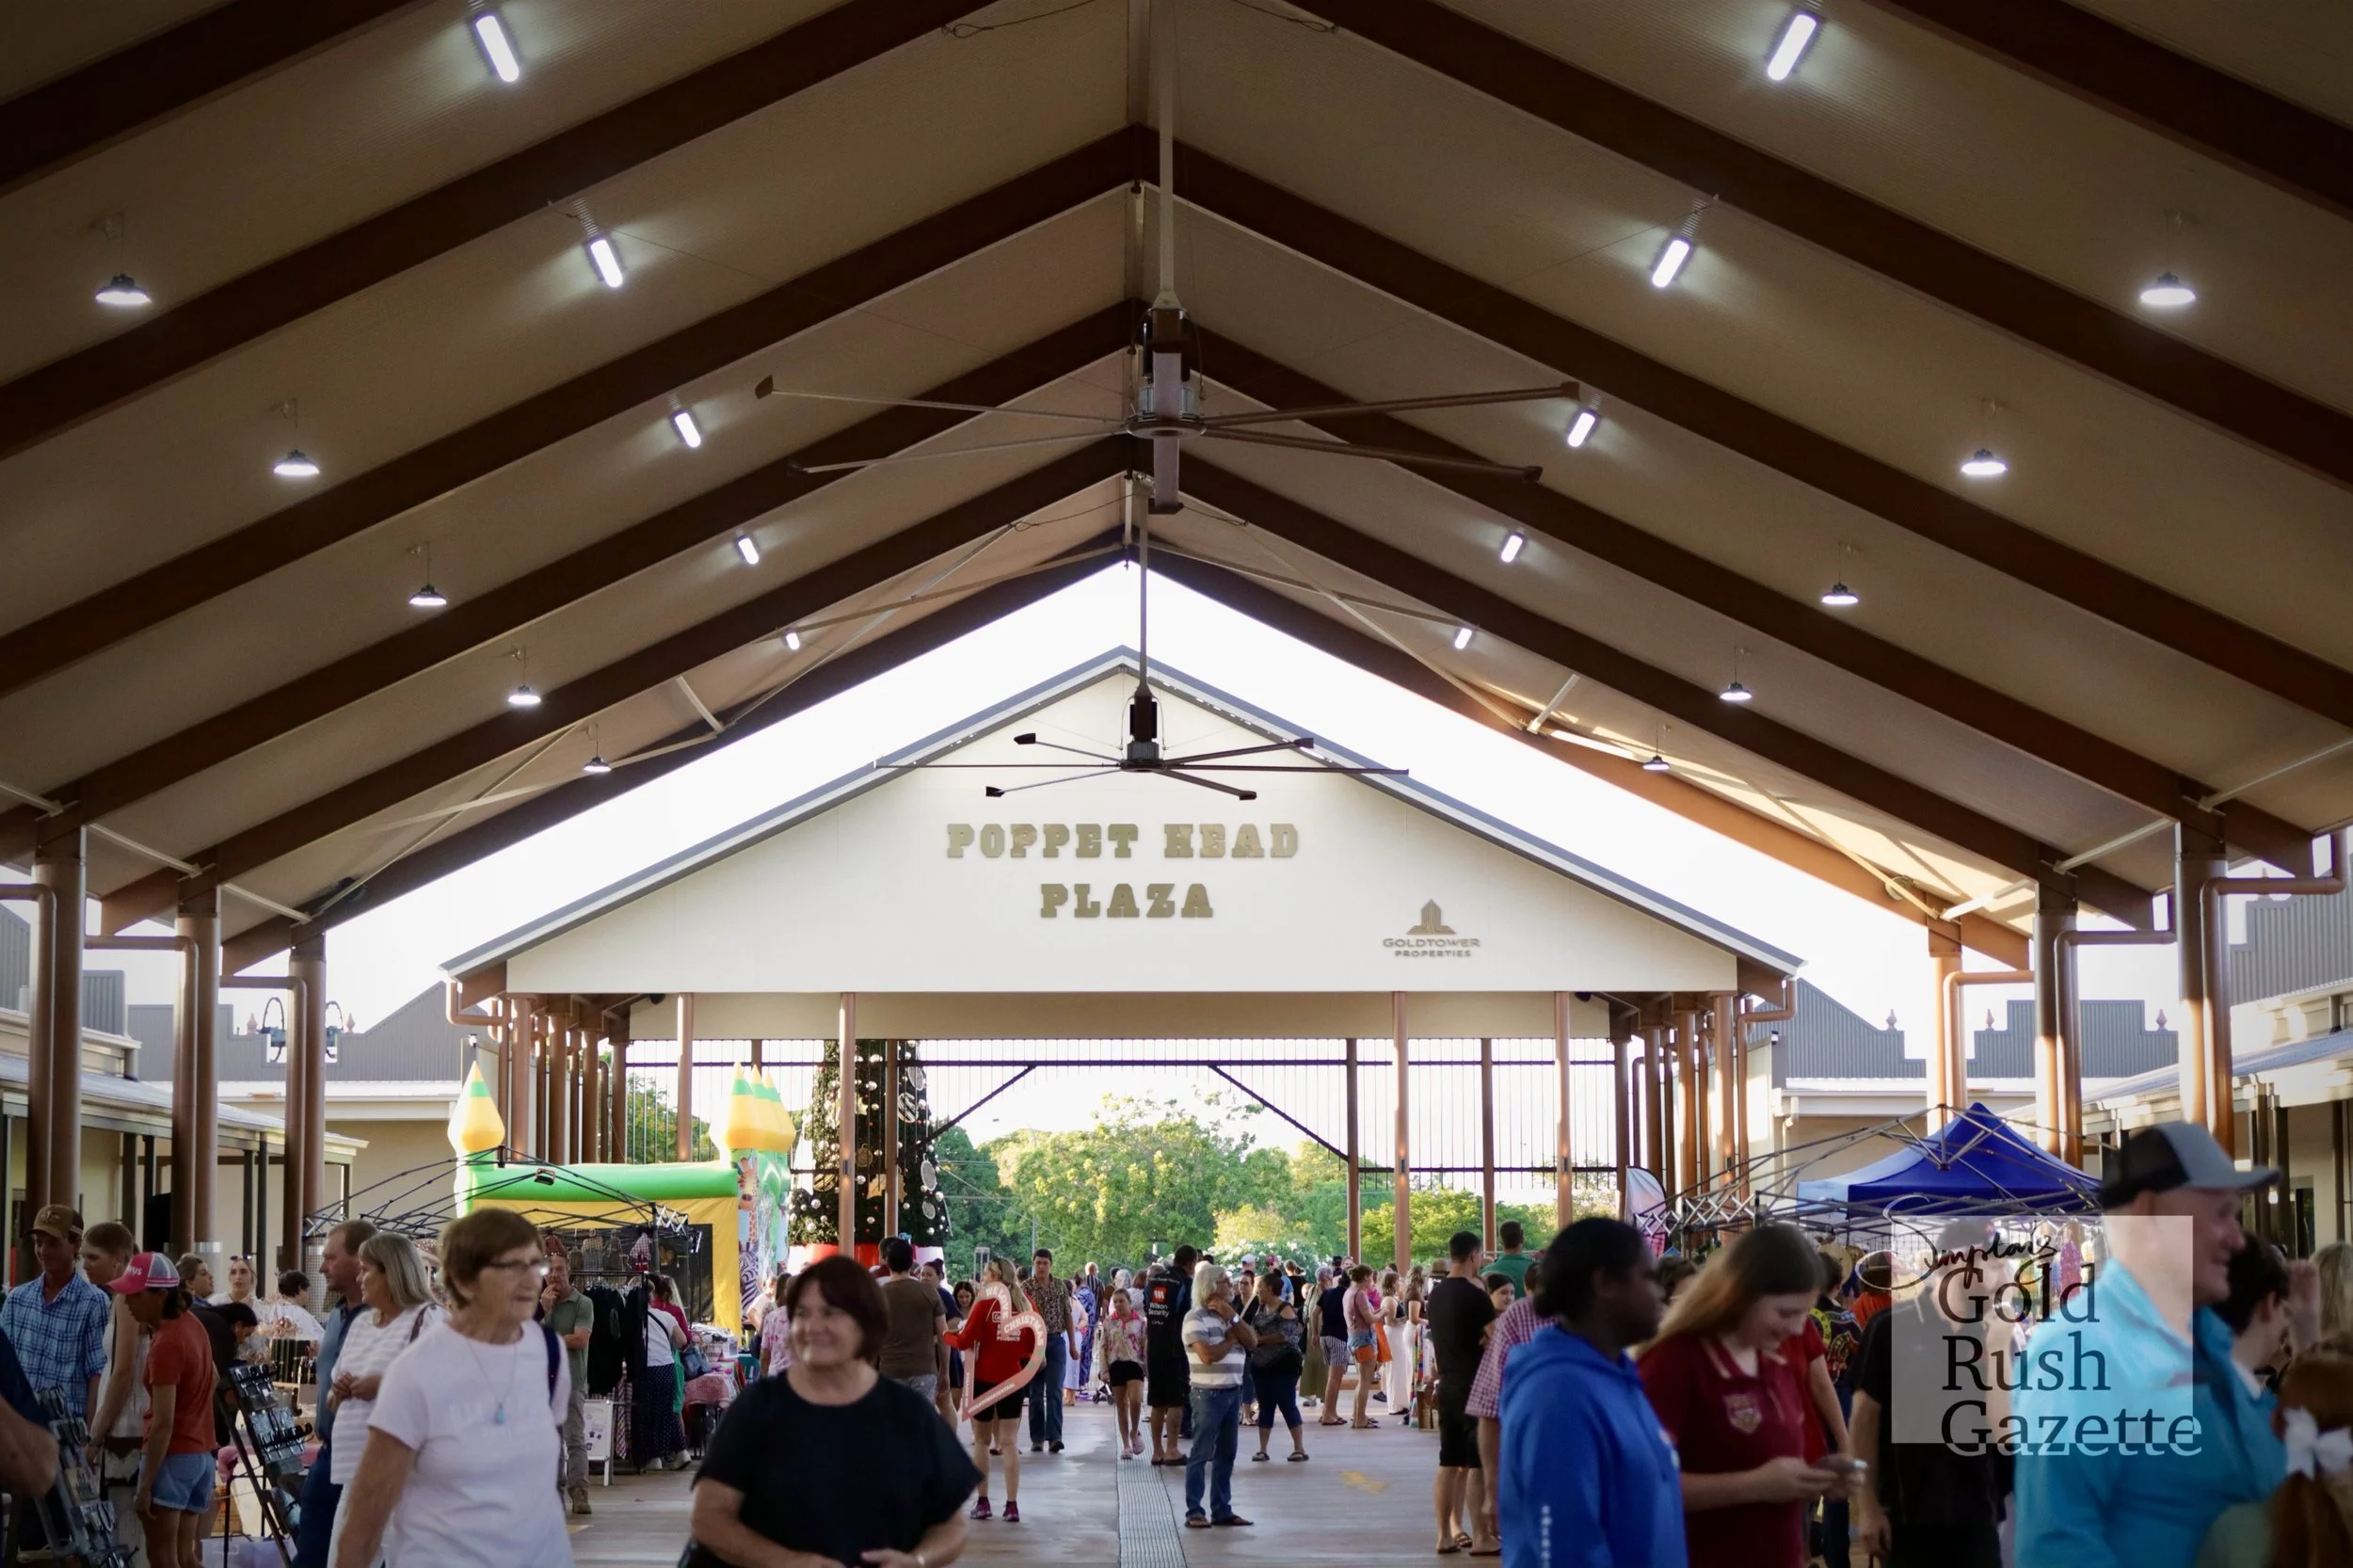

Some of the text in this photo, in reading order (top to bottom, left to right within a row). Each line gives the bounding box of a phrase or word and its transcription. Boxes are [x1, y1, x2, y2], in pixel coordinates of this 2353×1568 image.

[947, 823, 1299, 858] POPPET HEAD
[1040, 883, 1213, 918] PLAZA
[1383, 937, 1481, 948] GOLDTOWER
[985, 1286, 999, 1297] WE
[998, 1289, 1008, 1320] LOVE
[1003, 1315, 1044, 1346] CHRISTMAS
